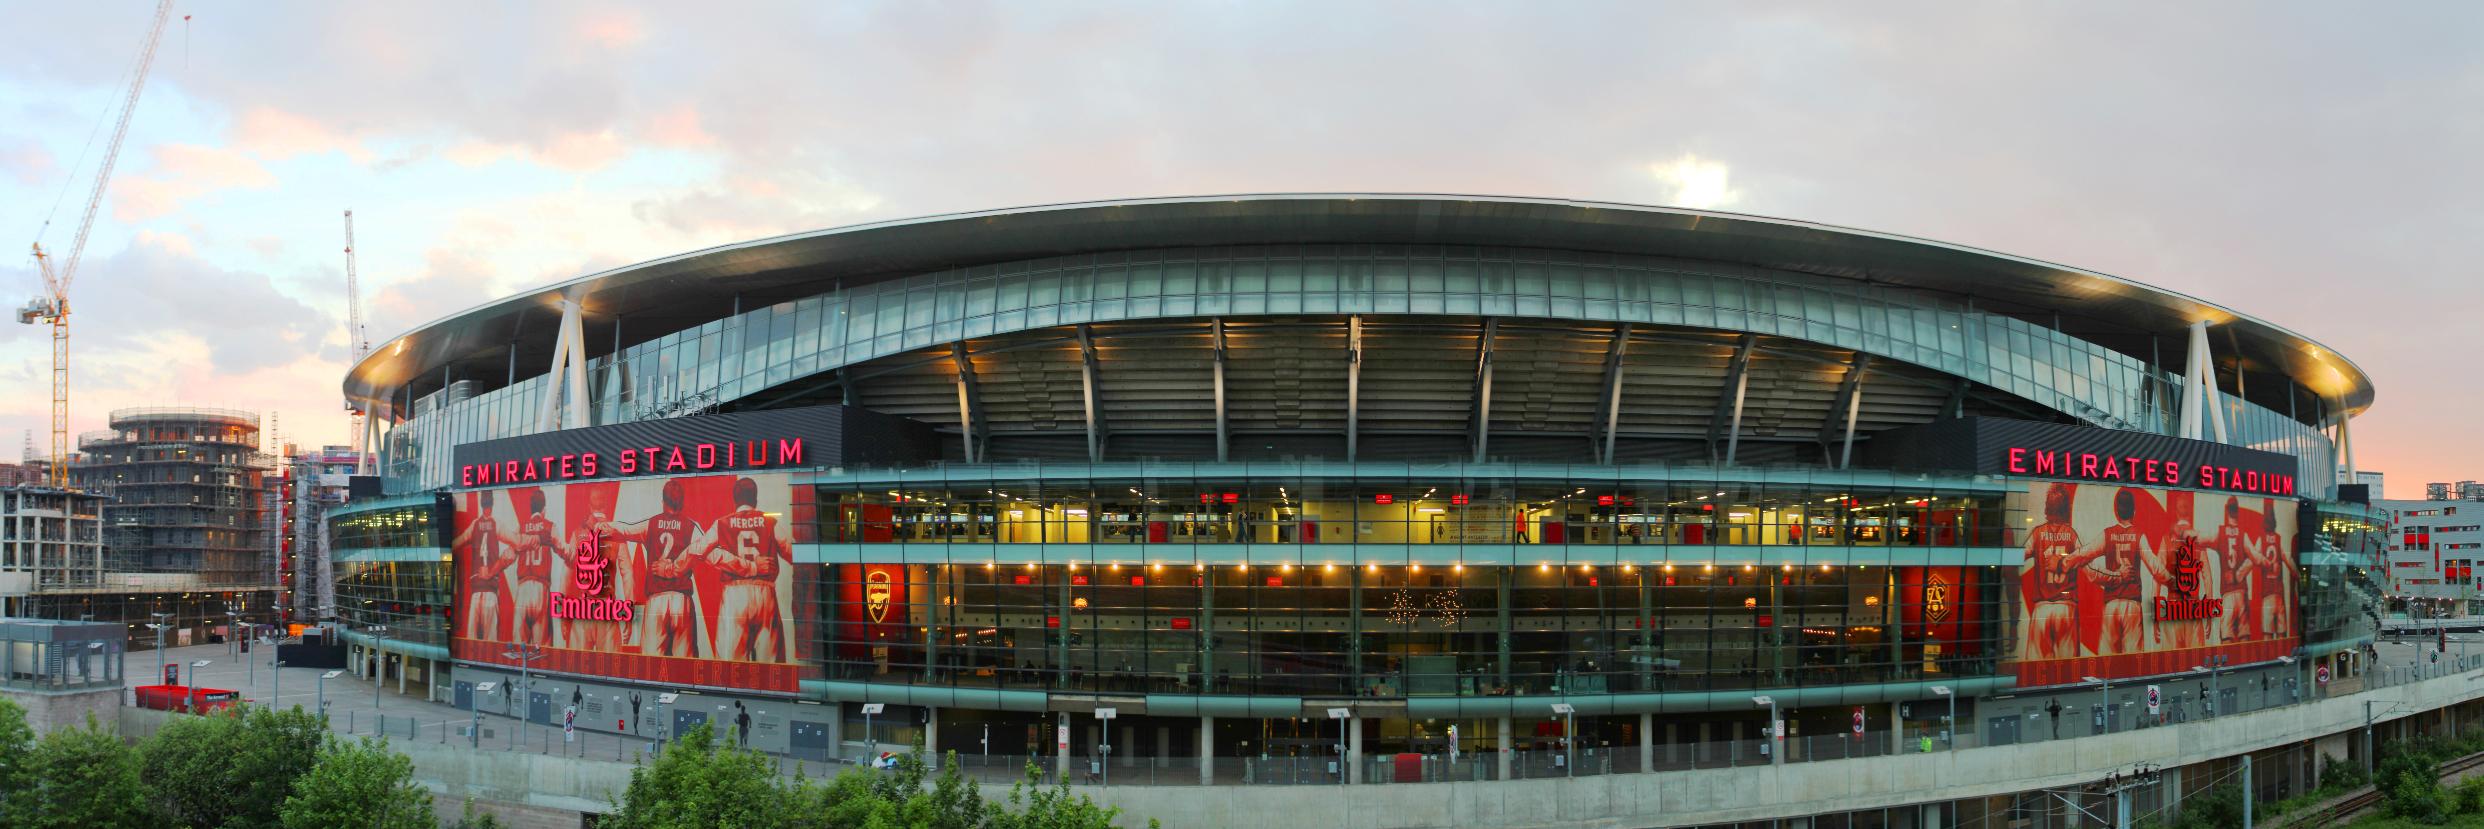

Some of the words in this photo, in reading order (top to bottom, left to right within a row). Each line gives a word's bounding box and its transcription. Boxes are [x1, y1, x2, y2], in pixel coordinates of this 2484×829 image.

[462, 453, 598, 486] EMIRATES
[620, 438, 802, 473] STADIUM
[2009, 447, 2179, 483] EMIRATES
[2201, 465, 2293, 495] STADIUM
[658, 519, 681, 530] DIXON
[730, 516, 764, 528] MERCER
[480, 532, 488, 566] 4
[659, 532, 673, 561] 2
[737, 531, 760, 571] 6
[2228, 537, 2237, 569] 5
[550, 592, 633, 622] Emirates
[2154, 594, 2223, 621] Emirates
[355, 645, 361, 653] L
[391, 655, 398, 663] K
[1902, 705, 1910, 717] H
